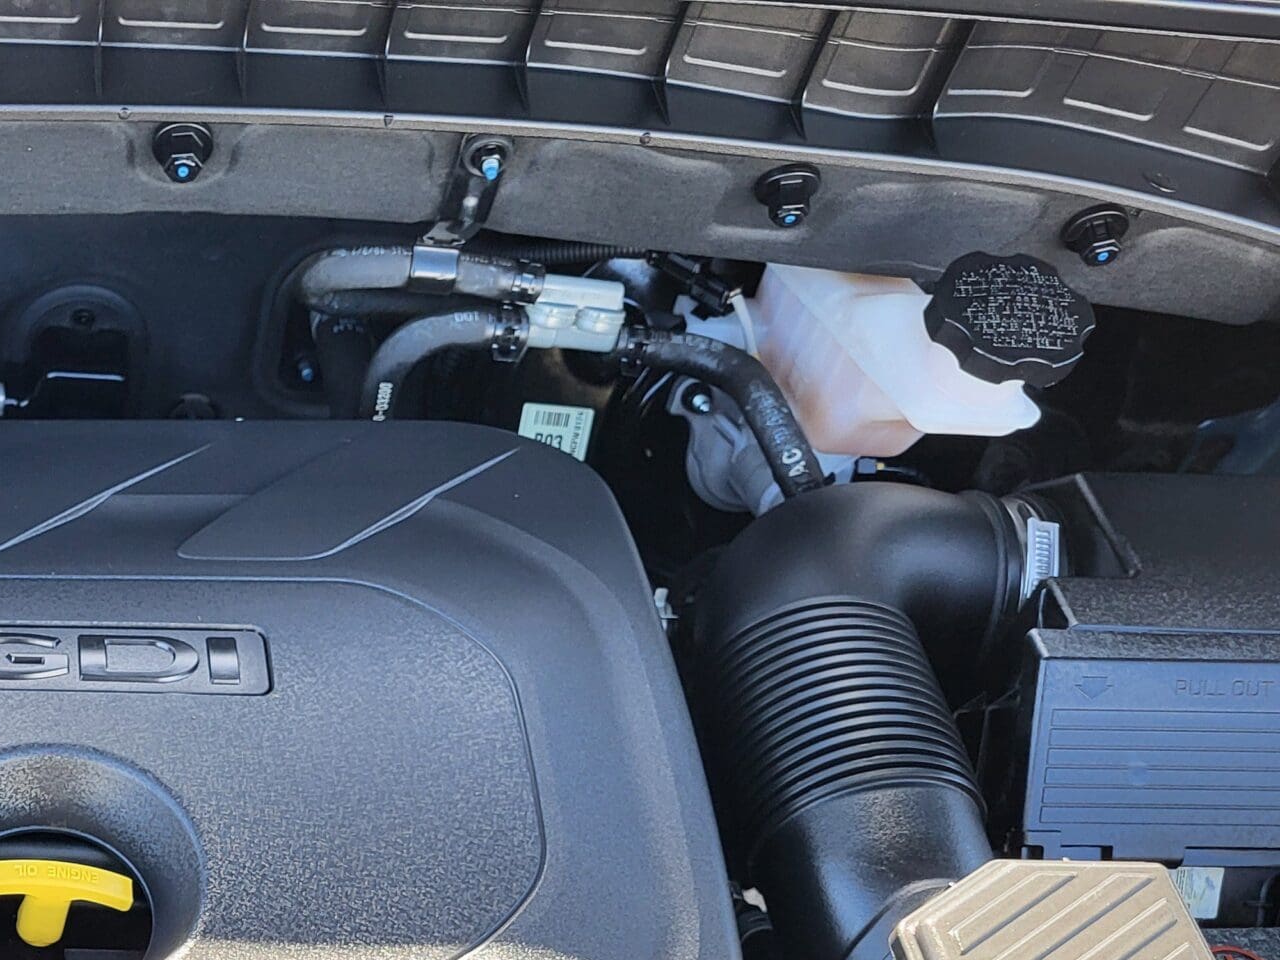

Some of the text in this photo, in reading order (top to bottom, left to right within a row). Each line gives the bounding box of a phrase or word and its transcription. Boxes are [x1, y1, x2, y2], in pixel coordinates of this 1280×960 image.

[1175, 679, 1276, 698] PULL OUT
[13, 863, 100, 884] ENGINE OIL
